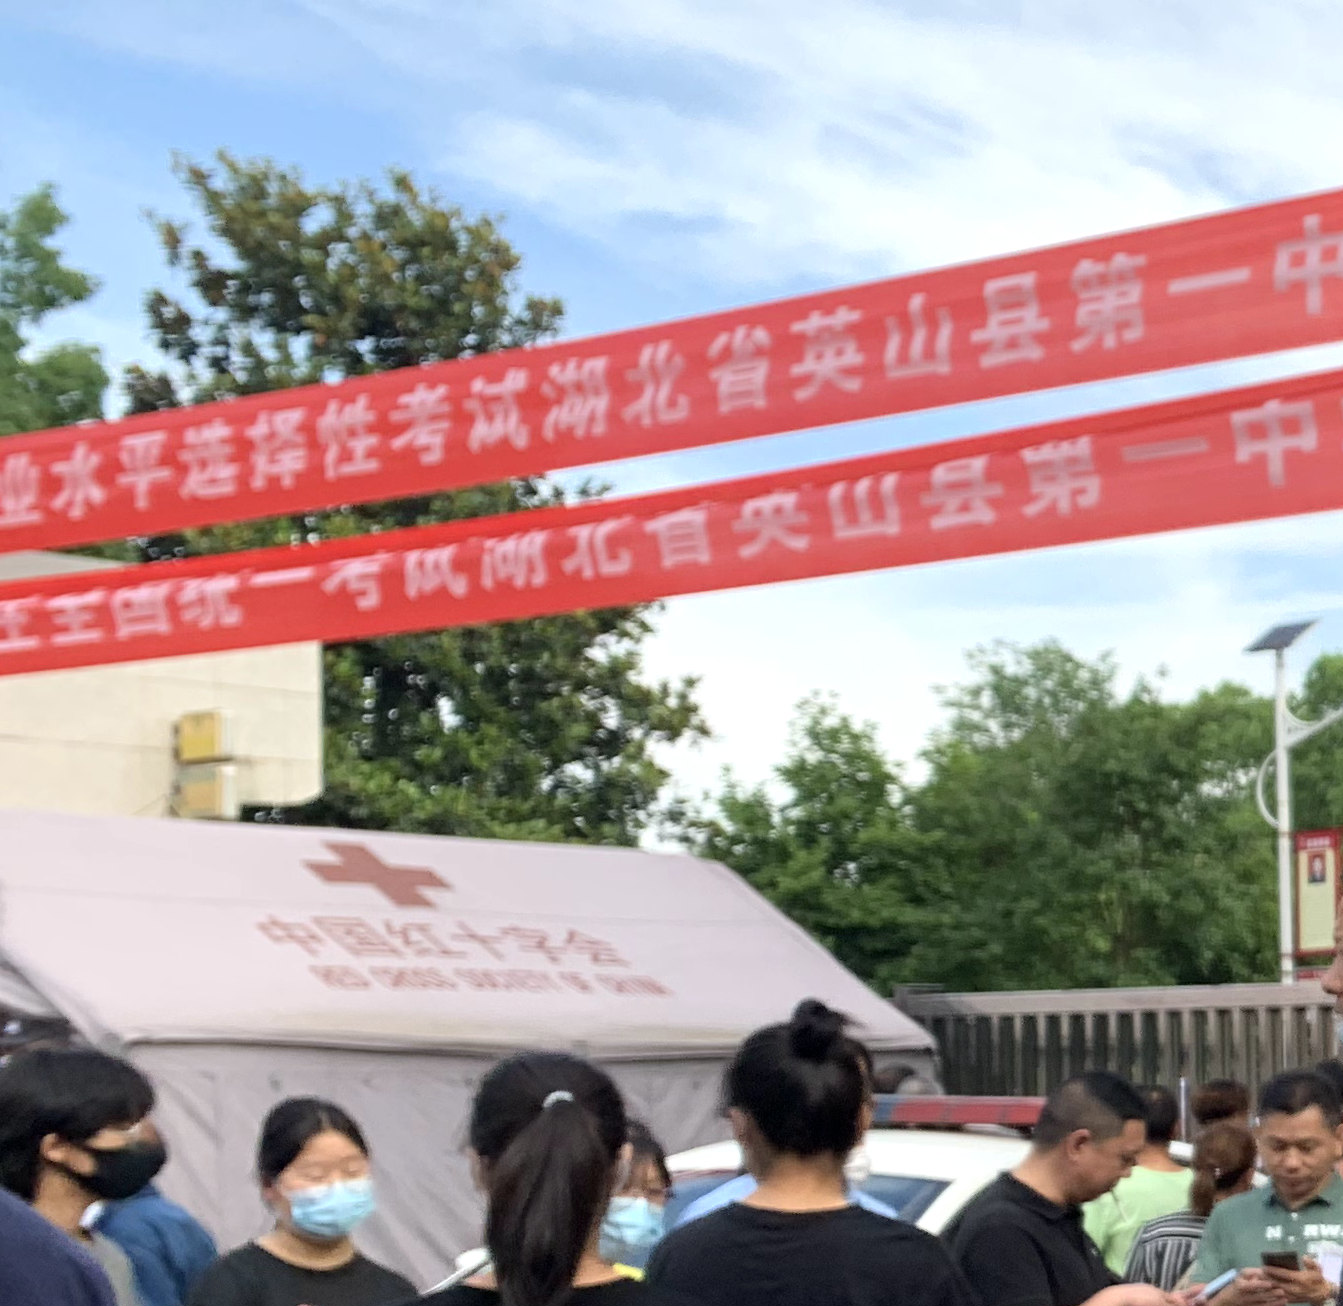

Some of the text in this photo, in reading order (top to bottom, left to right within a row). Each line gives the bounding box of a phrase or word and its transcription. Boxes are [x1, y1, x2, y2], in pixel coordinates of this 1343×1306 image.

[256, 915, 631, 968] 中国红十字会
